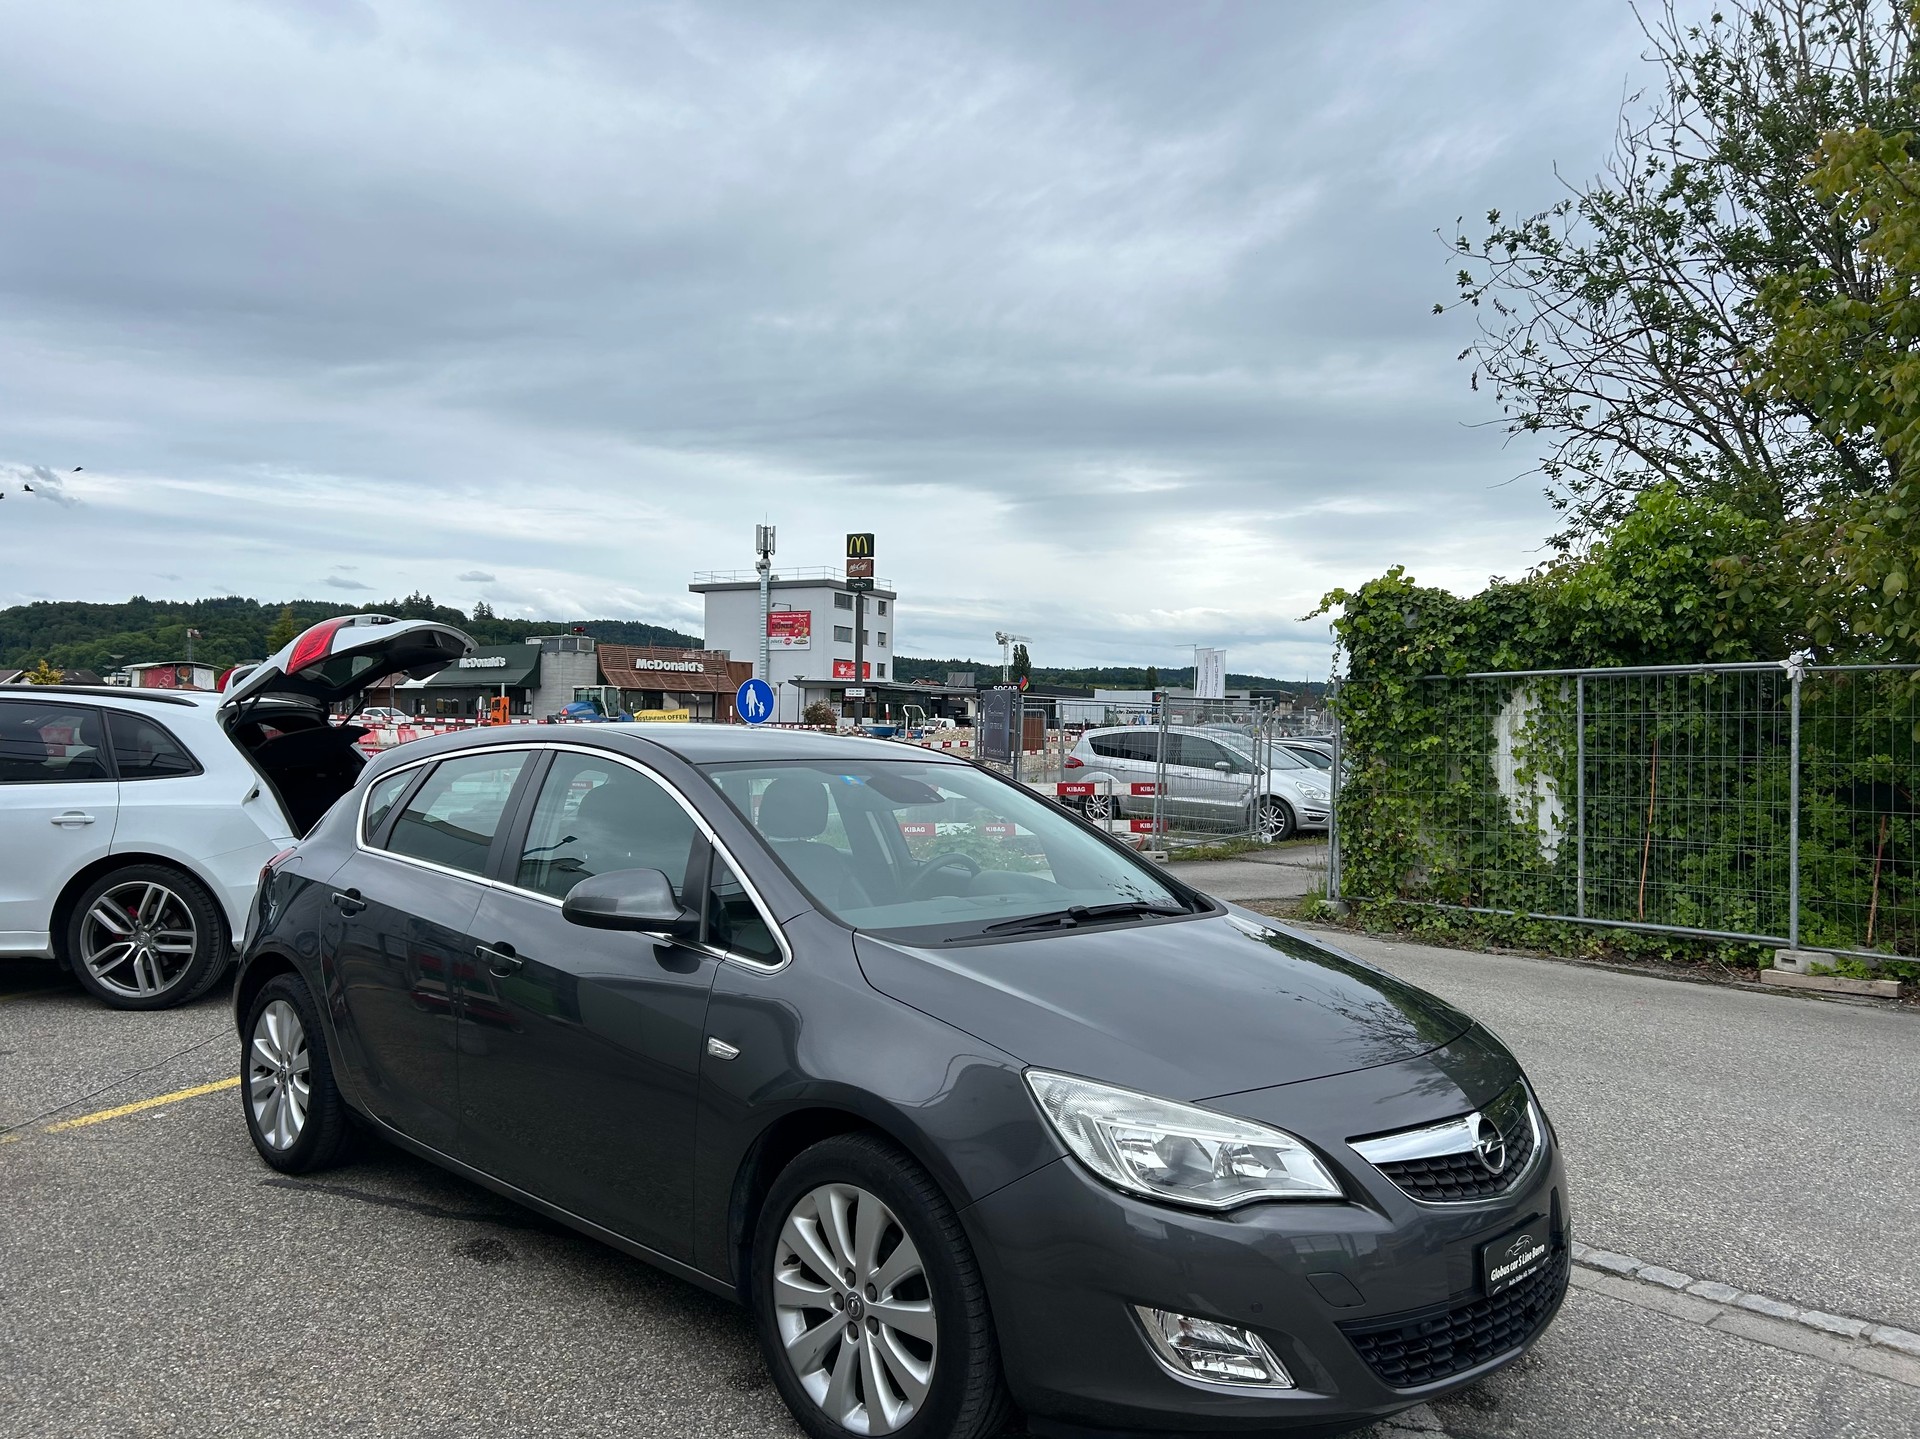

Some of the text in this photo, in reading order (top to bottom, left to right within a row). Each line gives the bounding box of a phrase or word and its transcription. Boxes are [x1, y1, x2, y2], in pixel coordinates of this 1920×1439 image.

[459, 656, 506, 668] McDonald's
[635, 658, 705, 673] McDonald's
[1510, 1260, 1518, 1271] car
